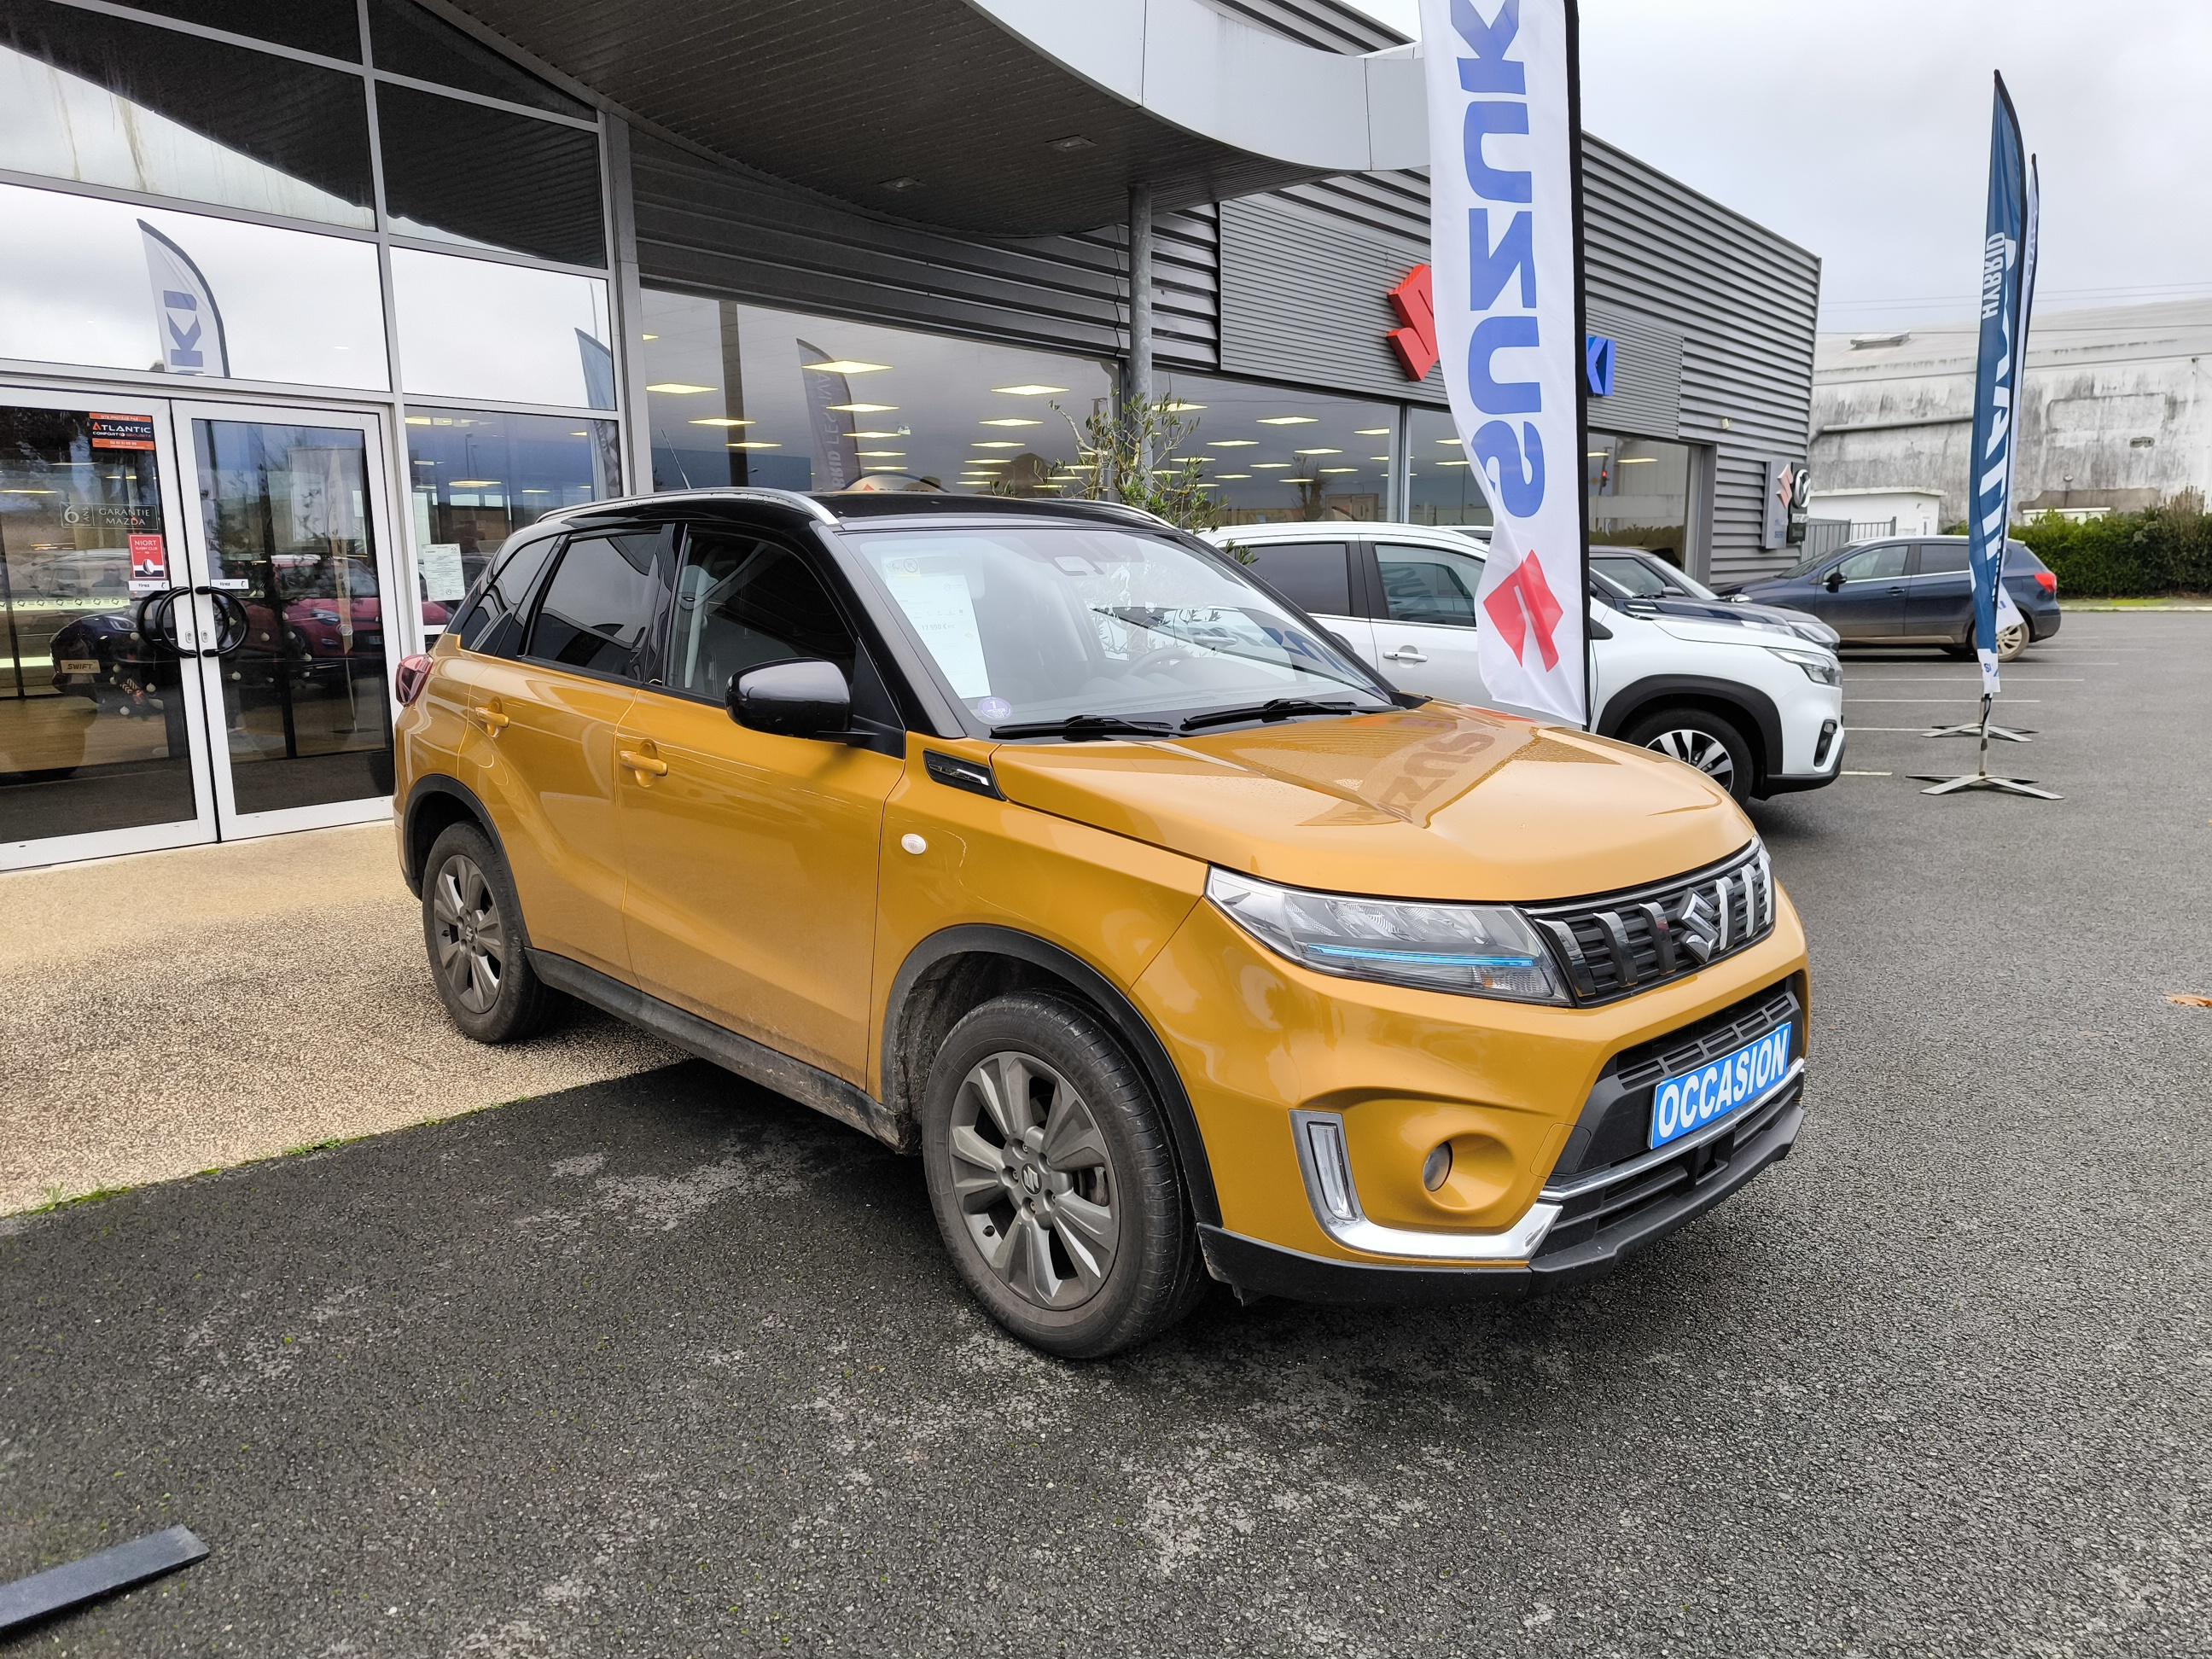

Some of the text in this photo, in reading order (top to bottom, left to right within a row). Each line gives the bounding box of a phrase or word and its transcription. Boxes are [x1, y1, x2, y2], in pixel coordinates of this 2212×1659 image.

[92, 422, 151, 434] ATLANTIC
[64, 504, 79, 523] 6
[98, 508, 151, 517] GARANTIE
[106, 517, 146, 526] MAZDA
[1657, 1029, 1790, 1138] OCCASION
